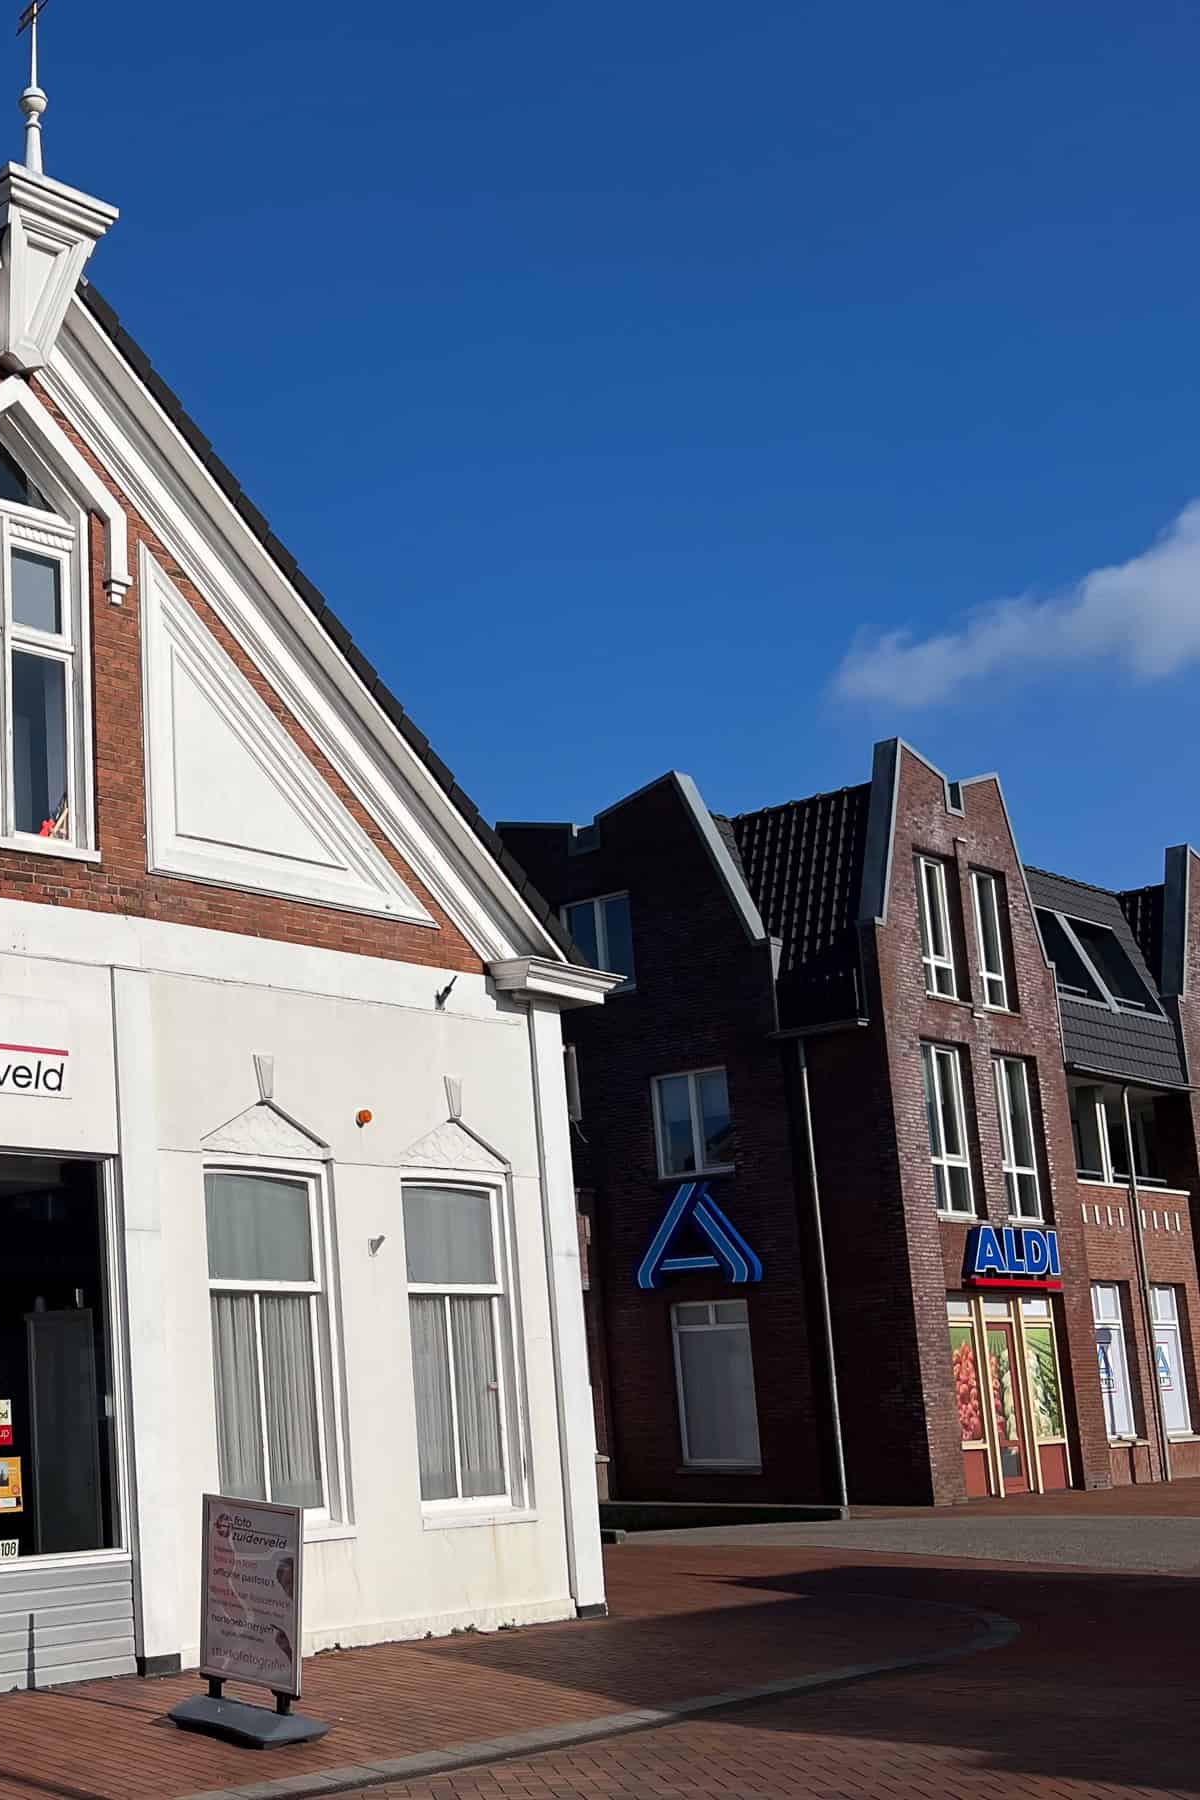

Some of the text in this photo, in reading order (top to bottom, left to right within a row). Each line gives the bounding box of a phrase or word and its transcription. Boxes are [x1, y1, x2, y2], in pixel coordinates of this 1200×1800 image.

[974, 1226, 1062, 1275] ALDI
[233, 1515, 252, 1529] foto
[232, 1531, 288, 1549] zuiderveld
